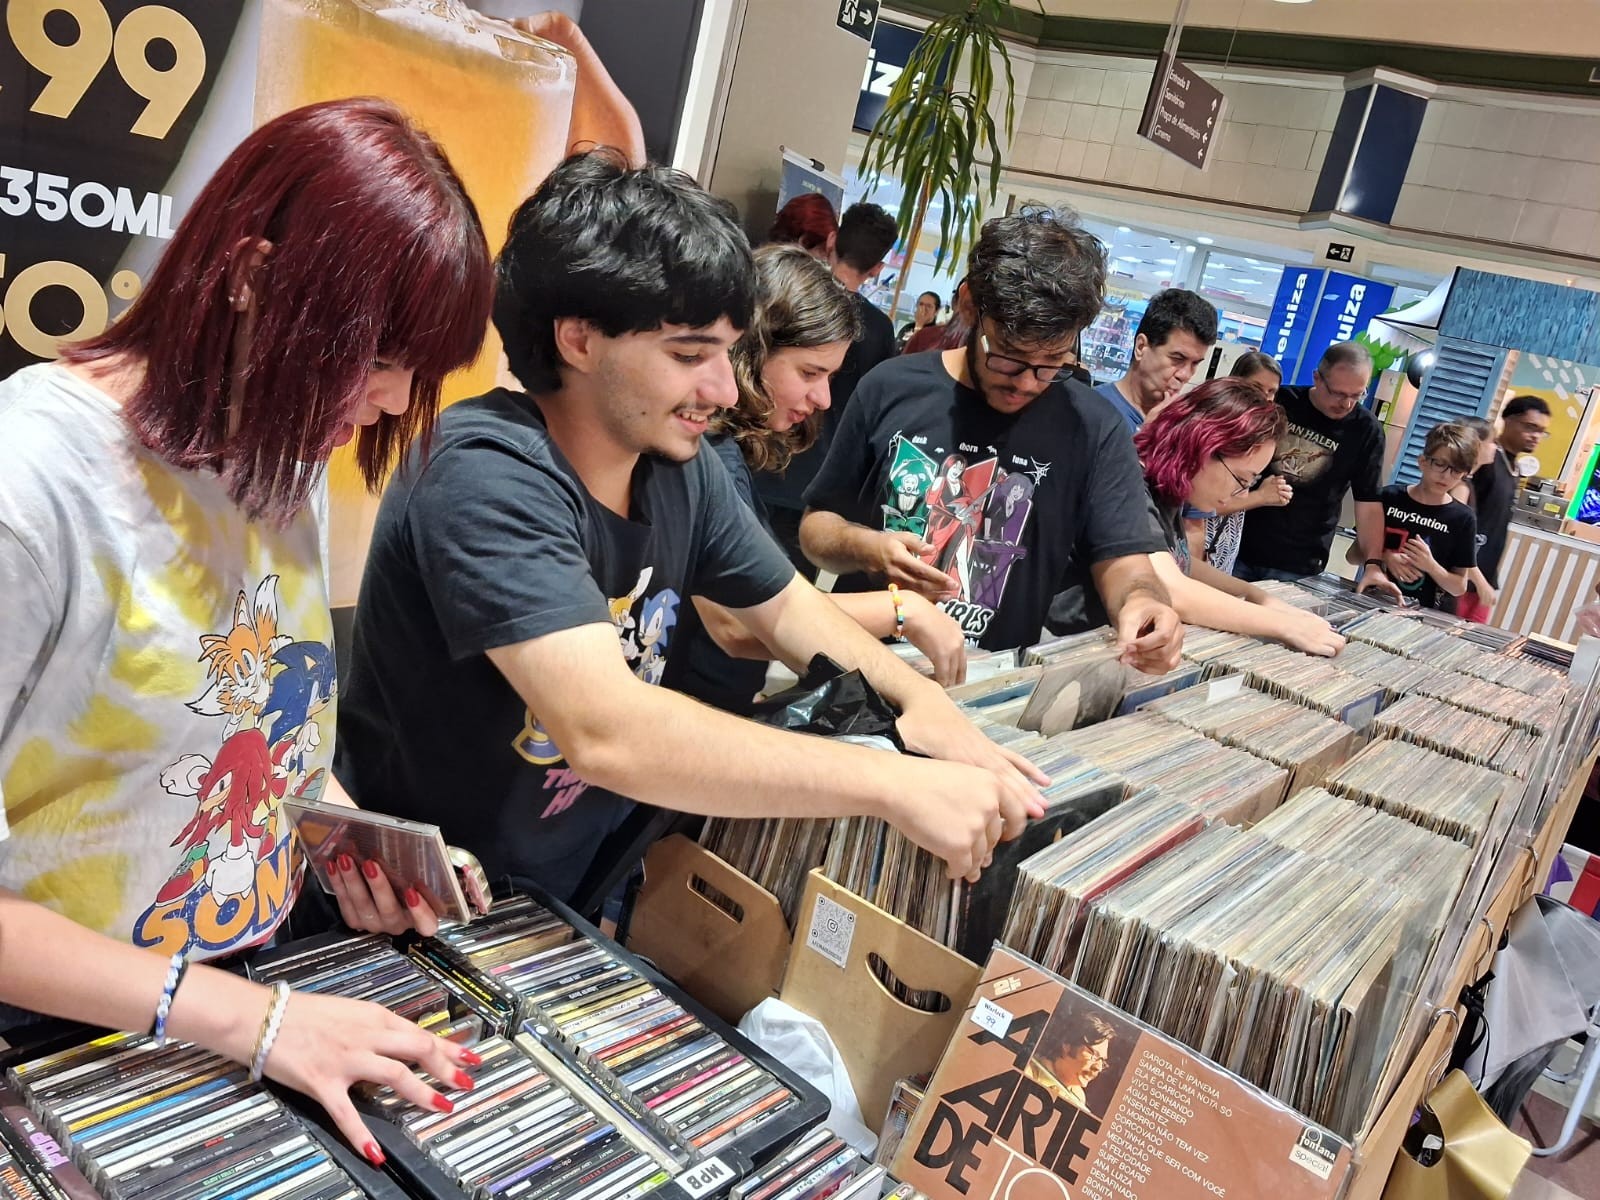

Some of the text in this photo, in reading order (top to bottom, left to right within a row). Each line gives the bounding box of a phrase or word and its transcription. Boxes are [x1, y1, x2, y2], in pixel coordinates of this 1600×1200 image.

[0, 166, 175, 239] 350ML
[1304, 430, 1339, 452] HALEN
[1386, 506, 1448, 533] PlayStation
[132, 828, 300, 957] SON
[967, 1009, 1051, 1072] A
[1134, 1067, 1149, 1080] ELA
[1156, 1080, 1191, 1106] CARIOCA
[1139, 1058, 1165, 1080] SAMBA
[1166, 1075, 1177, 1085] DE
[1178, 1082, 1196, 1096] UMA
[1197, 1093, 1218, 1110] NOTA
[1143, 1050, 1220, 1099] GAROTA DE IPANEMA
[1122, 1095, 1169, 1127] INSENSATEZ
[1132, 1077, 1194, 1118] VIVO SONHANDO
[1149, 1099, 1160, 1110] DE
[1160, 1105, 1187, 1126] BEBER
[941, 1069, 1102, 1186] ARTE
[1115, 1113, 1163, 1146] CORCOVADO
[1119, 1104, 1209, 1163] O MORRO NÃO TEM VEZ
[30, 1132, 70, 1168] POP
[913, 1100, 993, 1196] DE
[1101, 1140, 1153, 1176] A FELICIDADE
[1106, 1130, 1149, 1162] MEDITAÇÃO
[1123, 1129, 1146, 1148] TINHA
[1147, 1144, 1164, 1159] QUE
[1164, 1154, 1181, 1170] SER
[1181, 1166, 1201, 1183] COM
[1299, 1133, 1336, 1162] fontana
[686, 1163, 724, 1190] MPB
[1089, 1167, 1138, 1200] DESAFINADO
[1093, 1158, 1133, 1188] ANA LUIZA
[1097, 1149, 1146, 1184] SURF BOARD
[1085, 1176, 1113, 1199] BONITA
